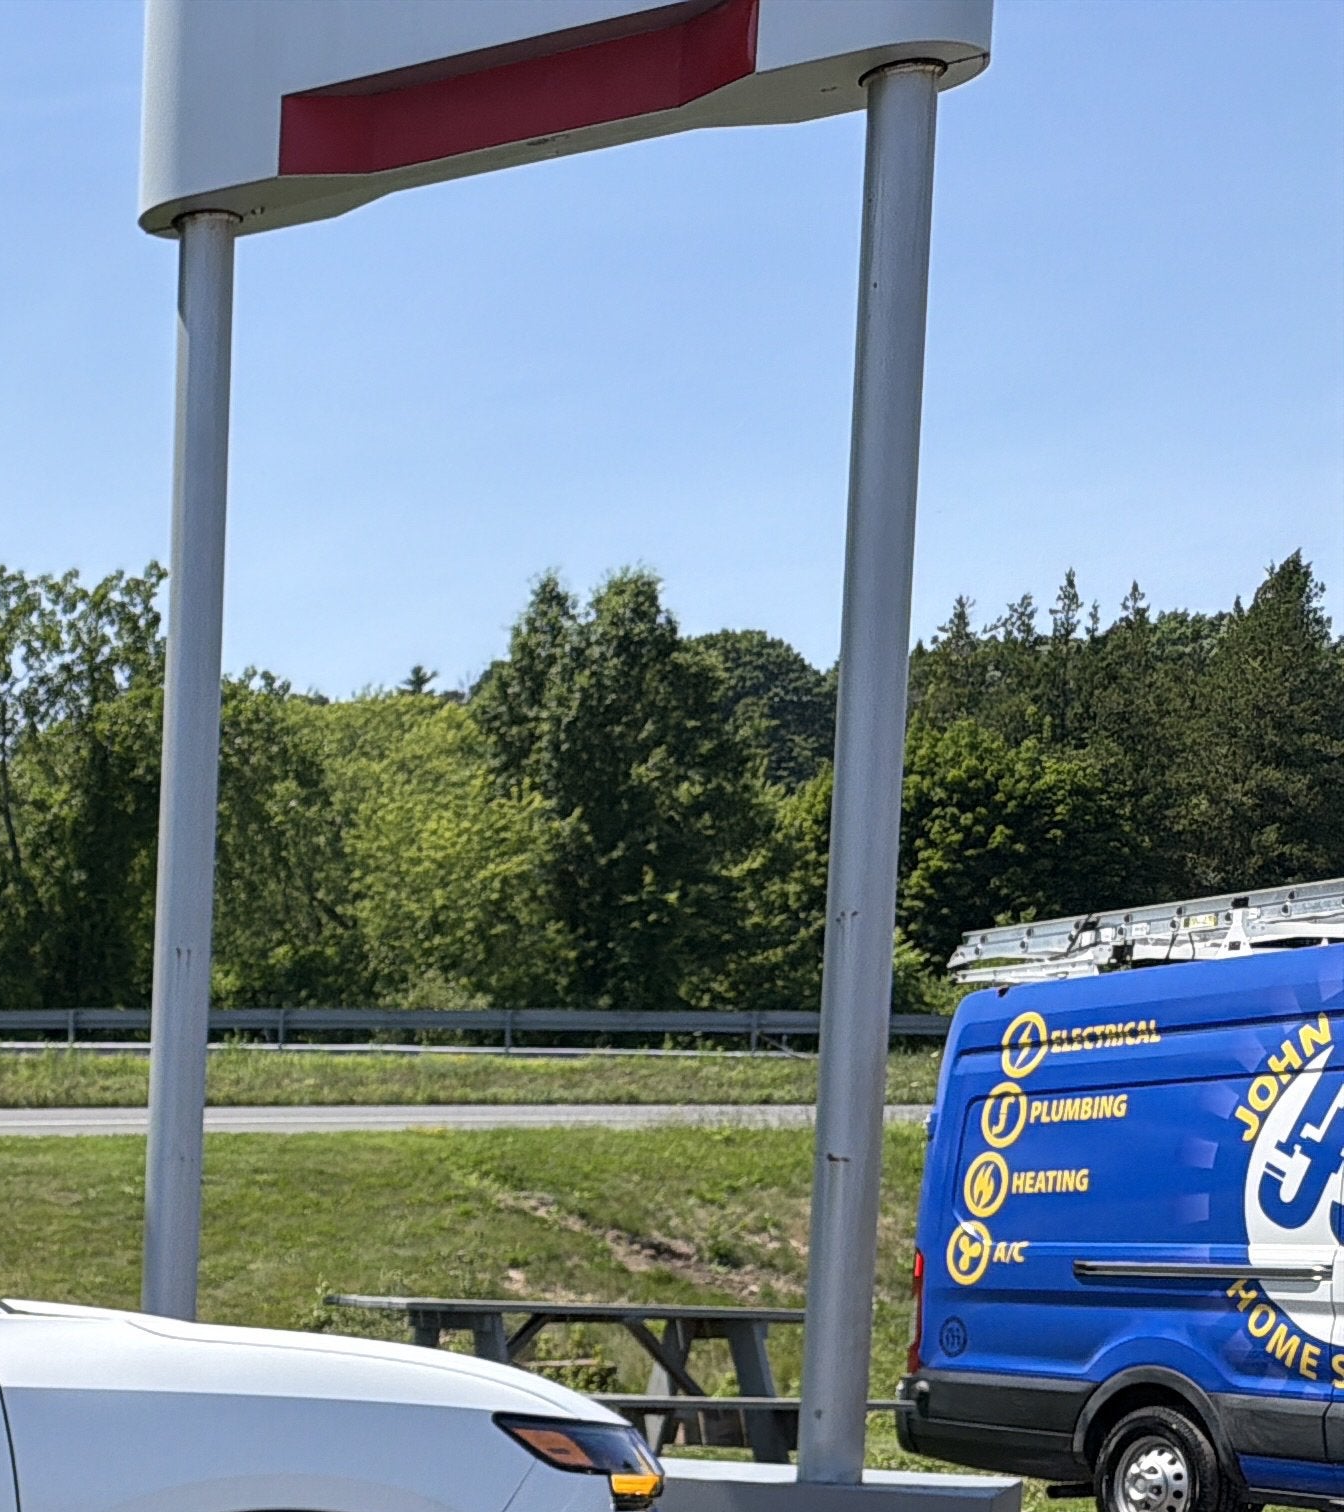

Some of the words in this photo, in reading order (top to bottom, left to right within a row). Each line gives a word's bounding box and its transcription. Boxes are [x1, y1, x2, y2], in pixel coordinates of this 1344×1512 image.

[1050, 1020, 1161, 1053] ELECTRICAL
[1234, 1012, 1332, 1141] JOHN
[1029, 1094, 1128, 1124] PLUMBING
[1011, 1168, 1089, 1194] HEATING
[992, 1241, 1029, 1264] A/C
[1226, 1278, 1321, 1380] HOME
